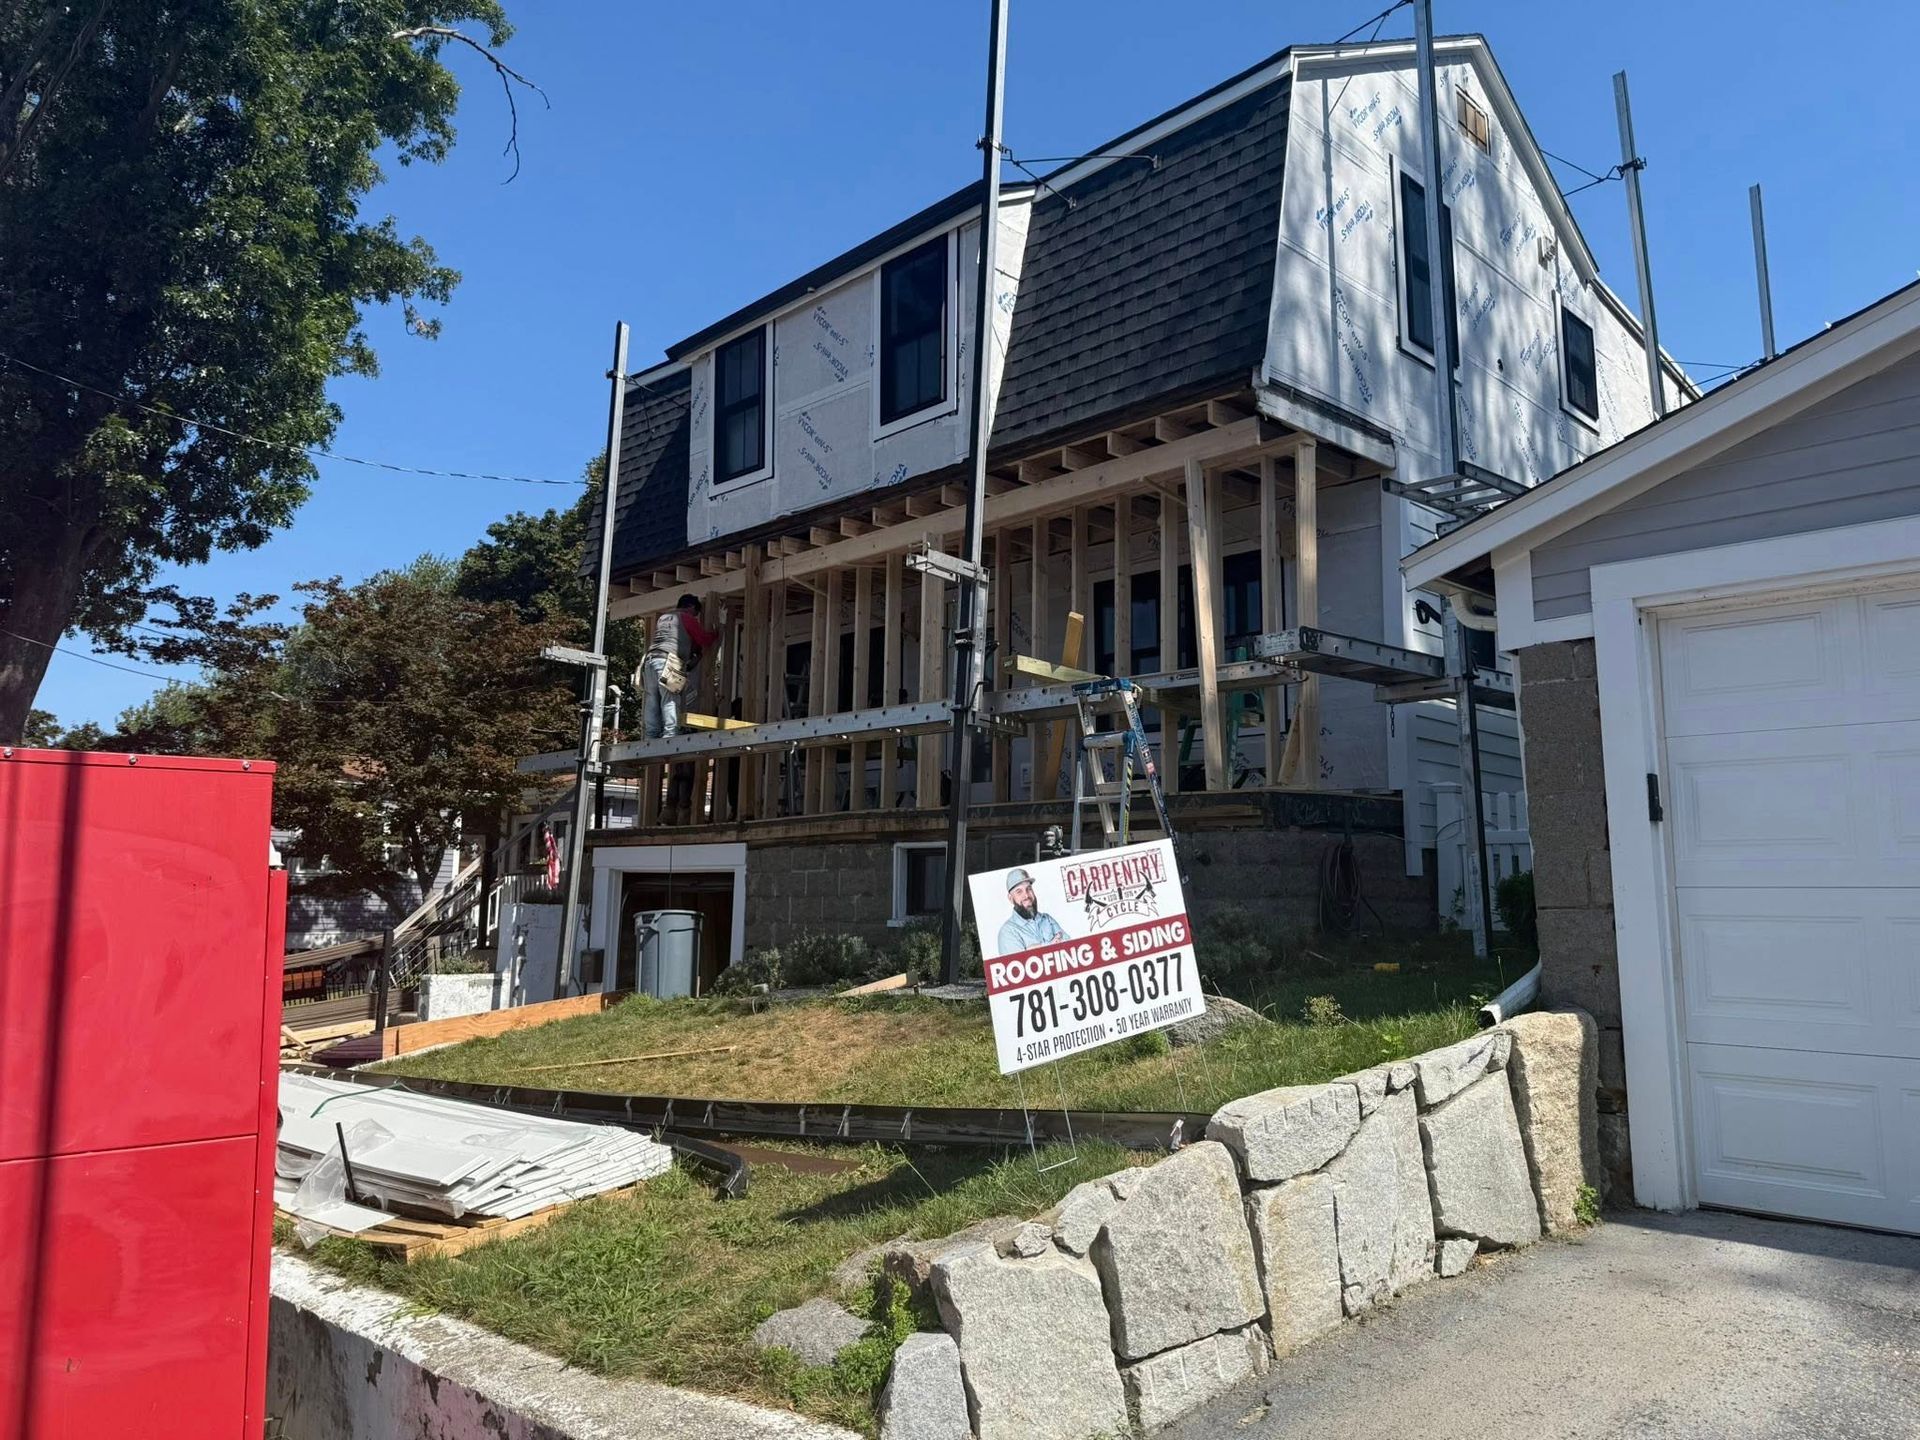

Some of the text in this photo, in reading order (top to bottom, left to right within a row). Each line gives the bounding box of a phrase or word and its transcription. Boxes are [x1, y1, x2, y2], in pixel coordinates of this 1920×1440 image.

[1067, 854, 1160, 897] CARPENTRY
[1106, 901, 1139, 918] CYCLE
[990, 921, 1185, 989] ROOFING & SIDING
[1009, 952, 1184, 1038] 781-308-0377
[1016, 997, 1193, 1064] 4-STAR PROTECTION 50 YEAR WARRANTY
